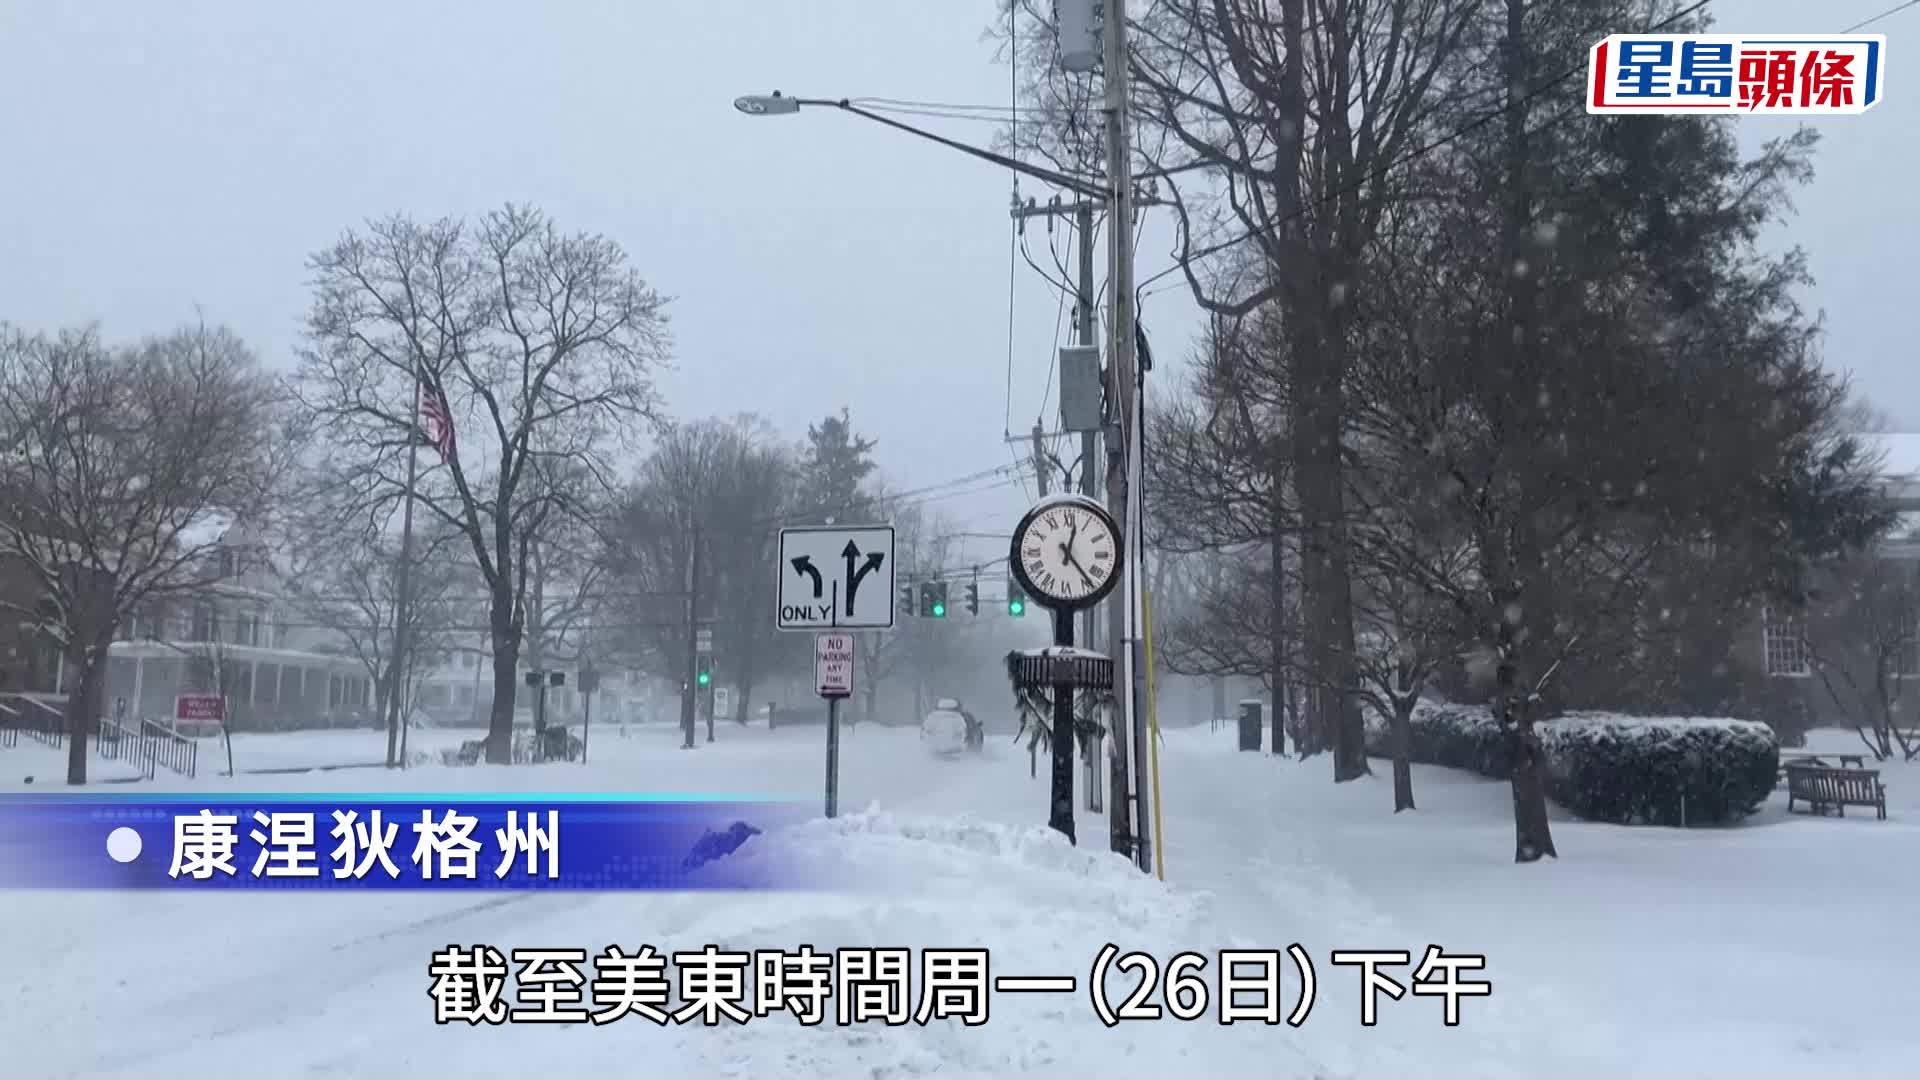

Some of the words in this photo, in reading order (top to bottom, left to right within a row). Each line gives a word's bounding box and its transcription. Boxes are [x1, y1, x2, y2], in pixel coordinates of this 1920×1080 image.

[782, 605, 832, 622] ONLY
[827, 639, 843, 650] NO
[818, 652, 852, 663] PARKING
[827, 663, 843, 673] ANY
[825, 674, 843, 684] TIME
